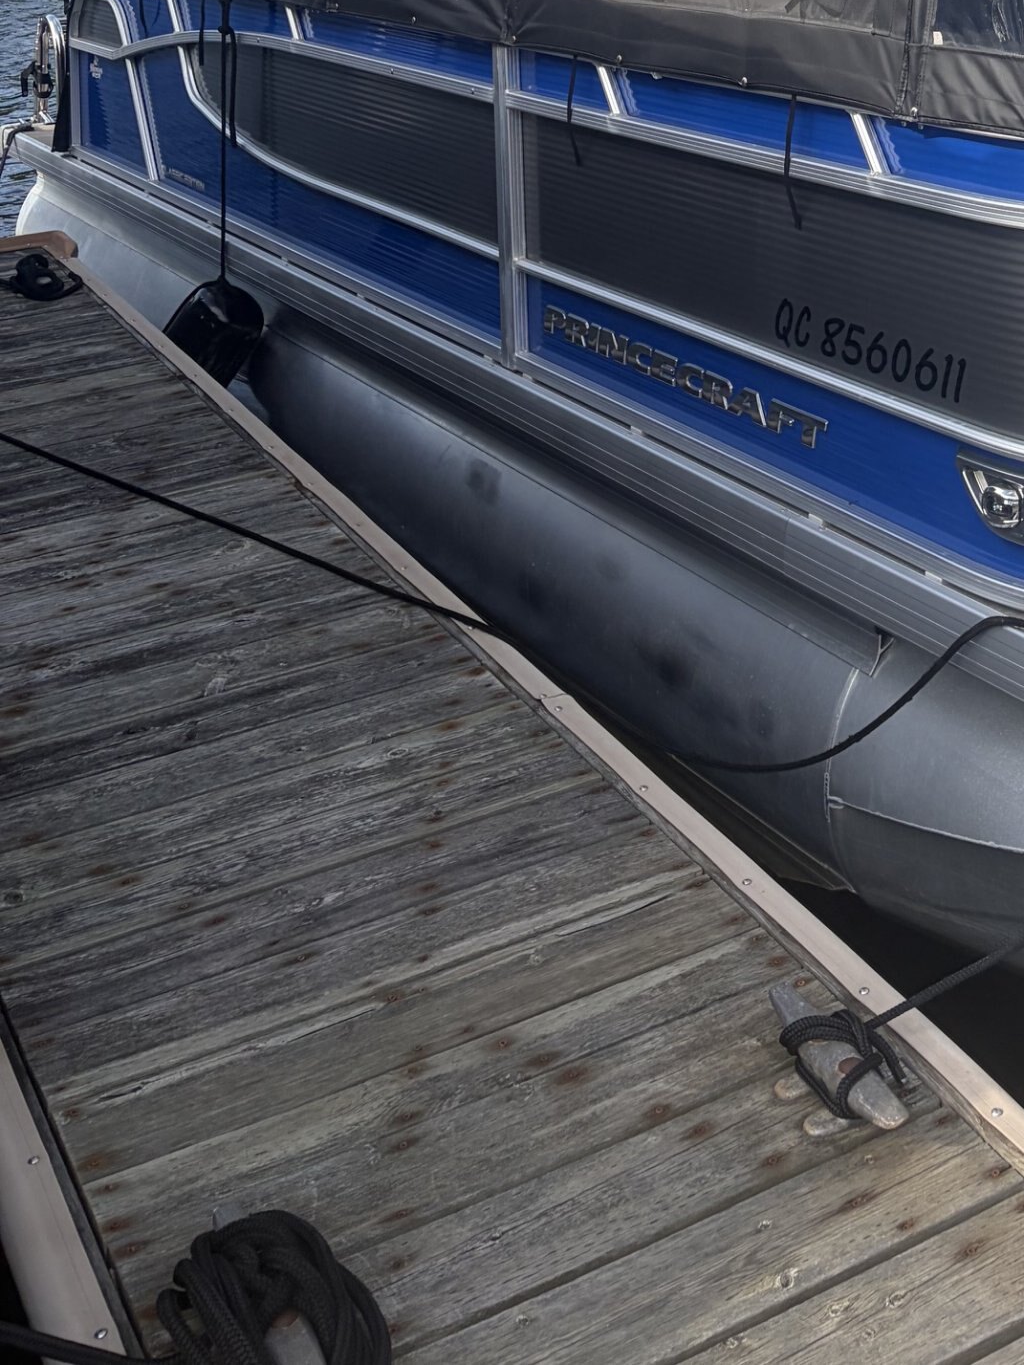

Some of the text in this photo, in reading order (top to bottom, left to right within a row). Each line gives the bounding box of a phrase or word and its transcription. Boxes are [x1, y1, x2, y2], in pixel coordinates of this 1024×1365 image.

[543, 304, 828, 449] PRINCECRAFT
[774, 297, 967, 403] QC 8560611
